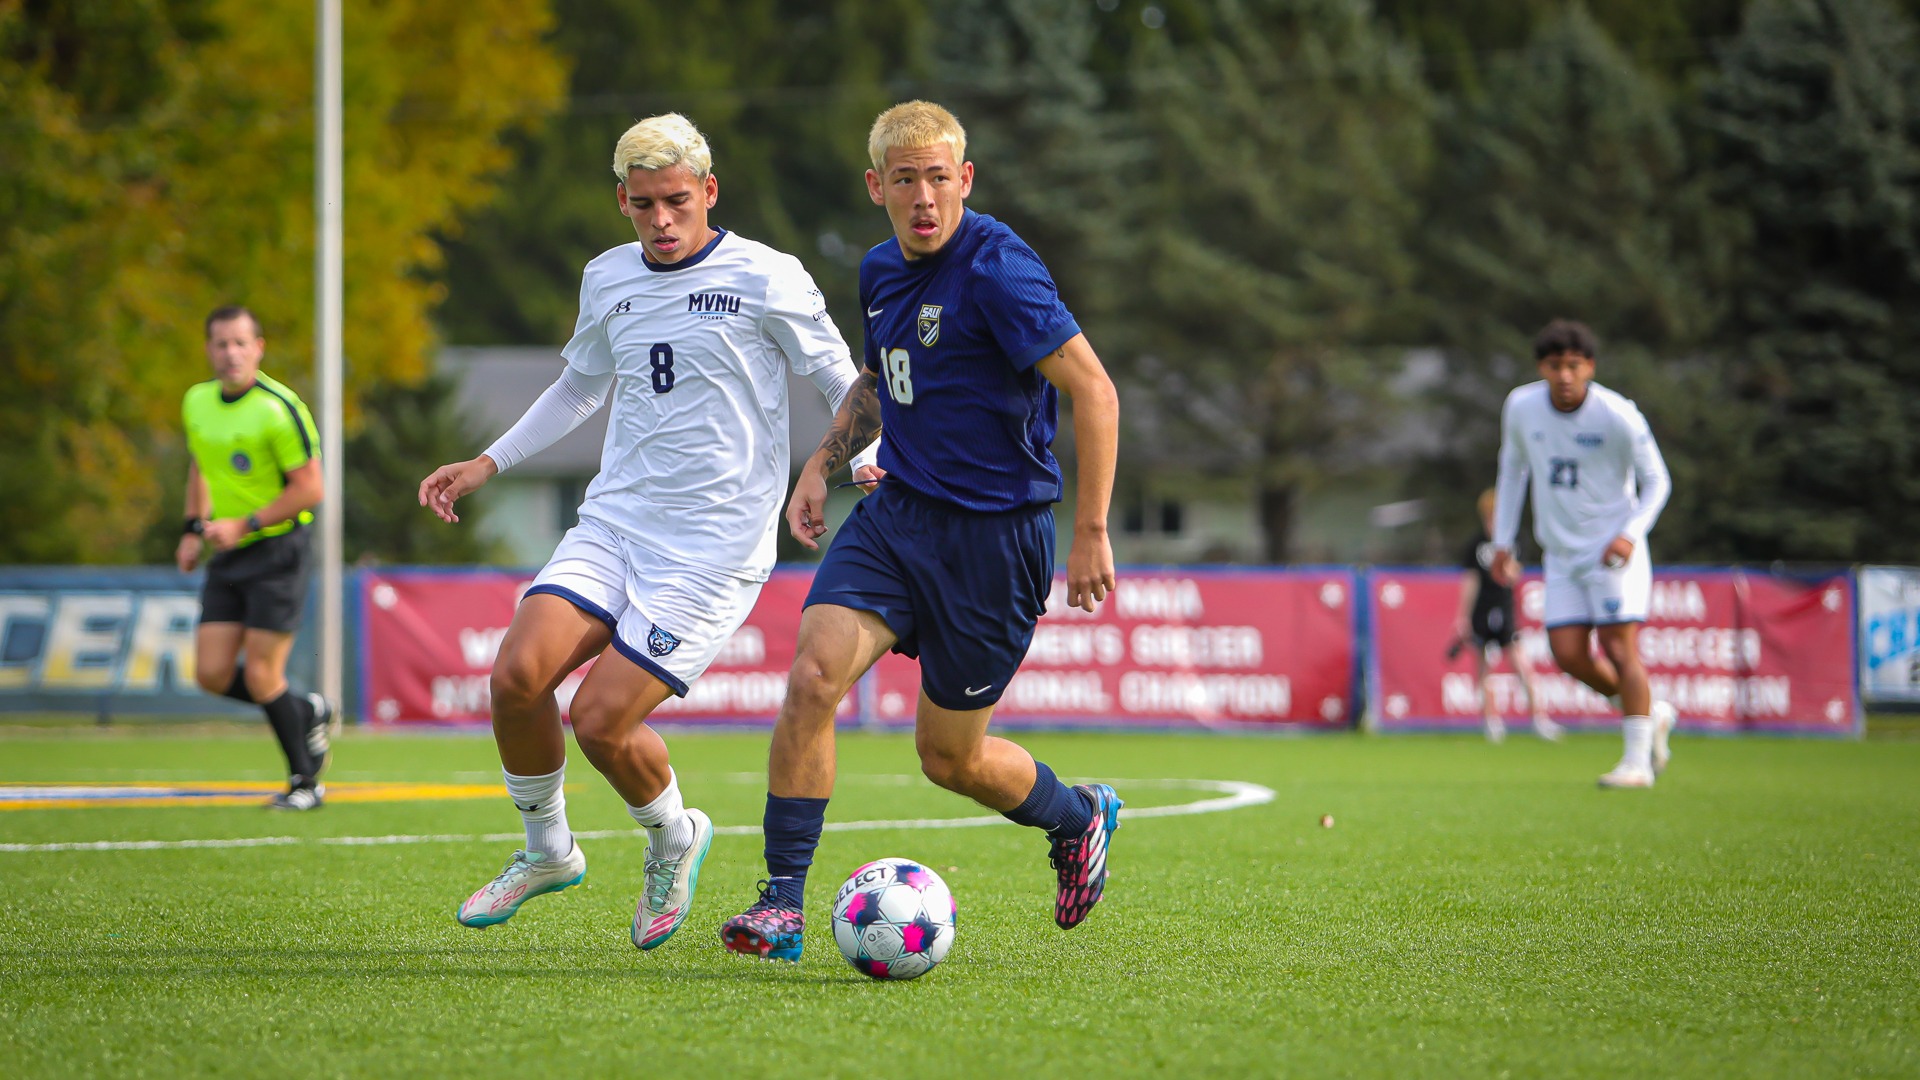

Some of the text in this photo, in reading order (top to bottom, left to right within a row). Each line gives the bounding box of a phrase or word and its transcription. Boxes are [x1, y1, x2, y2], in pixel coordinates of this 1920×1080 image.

[688, 293, 741, 313] MVNU
[921, 306, 940, 319] SAU
[650, 343, 675, 393] 8
[880, 347, 914, 405] 18
[489, 883, 528, 917] F50
[833, 867, 887, 913] SELECT
